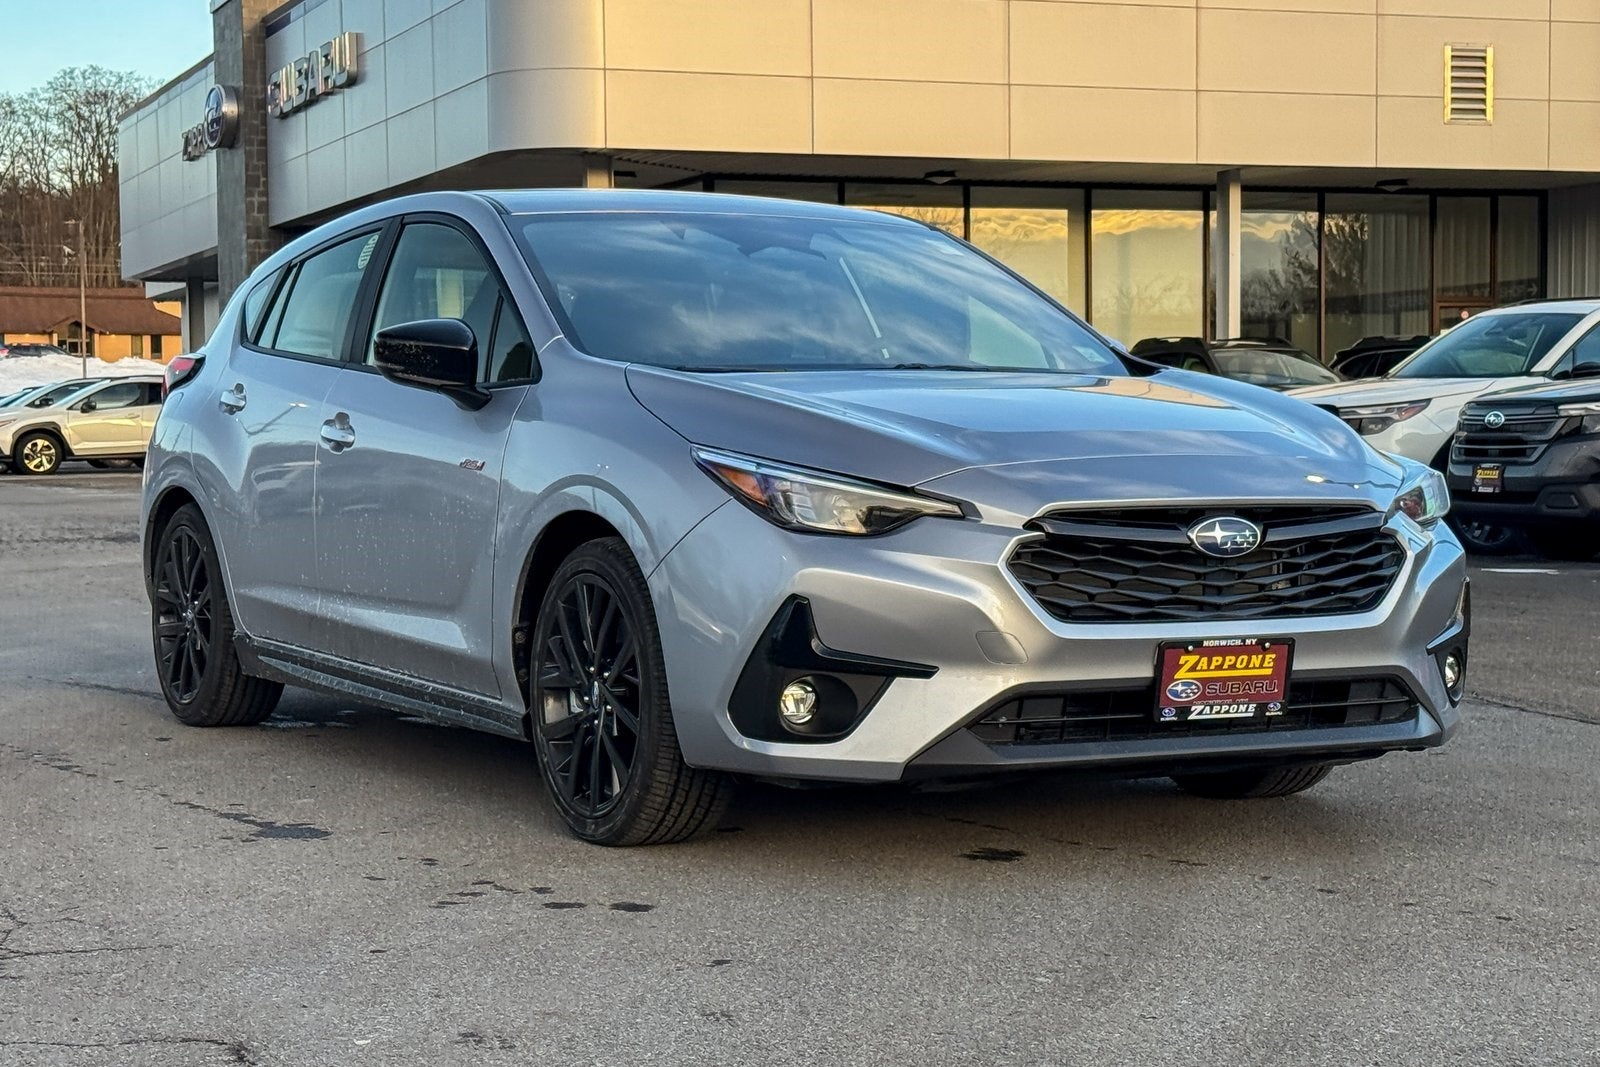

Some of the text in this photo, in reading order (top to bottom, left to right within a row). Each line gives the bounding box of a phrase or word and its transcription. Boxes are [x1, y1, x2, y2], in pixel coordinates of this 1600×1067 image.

[267, 31, 358, 118] SUBARU
[1245, 638, 1258, 646] NY
[1174, 653, 1276, 679] ZAPPONE
[1205, 680, 1277, 696] SUBARU
[1187, 703, 1257, 720] ZAPPONE
